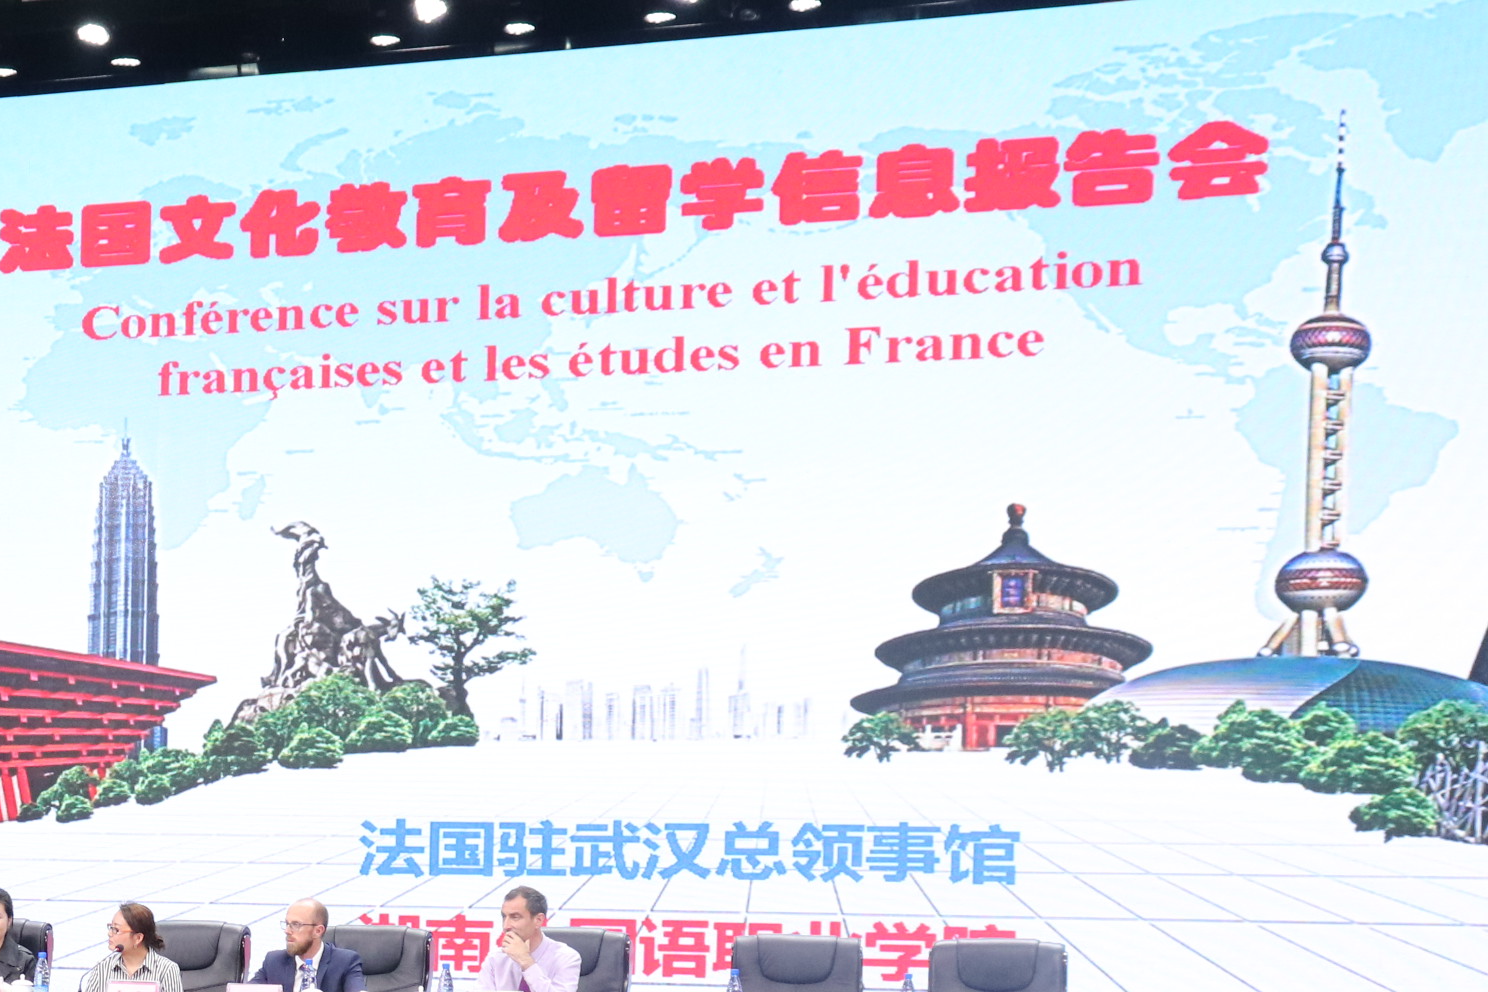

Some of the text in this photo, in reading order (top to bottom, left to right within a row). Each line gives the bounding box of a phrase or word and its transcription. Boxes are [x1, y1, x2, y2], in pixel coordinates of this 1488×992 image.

[81, 251, 1141, 341] Conférence sur la culture et l'éducation
[158, 327, 1045, 400] françaises et les études en France
[358, 818, 1021, 885] 法国驻武汉总领事馆
